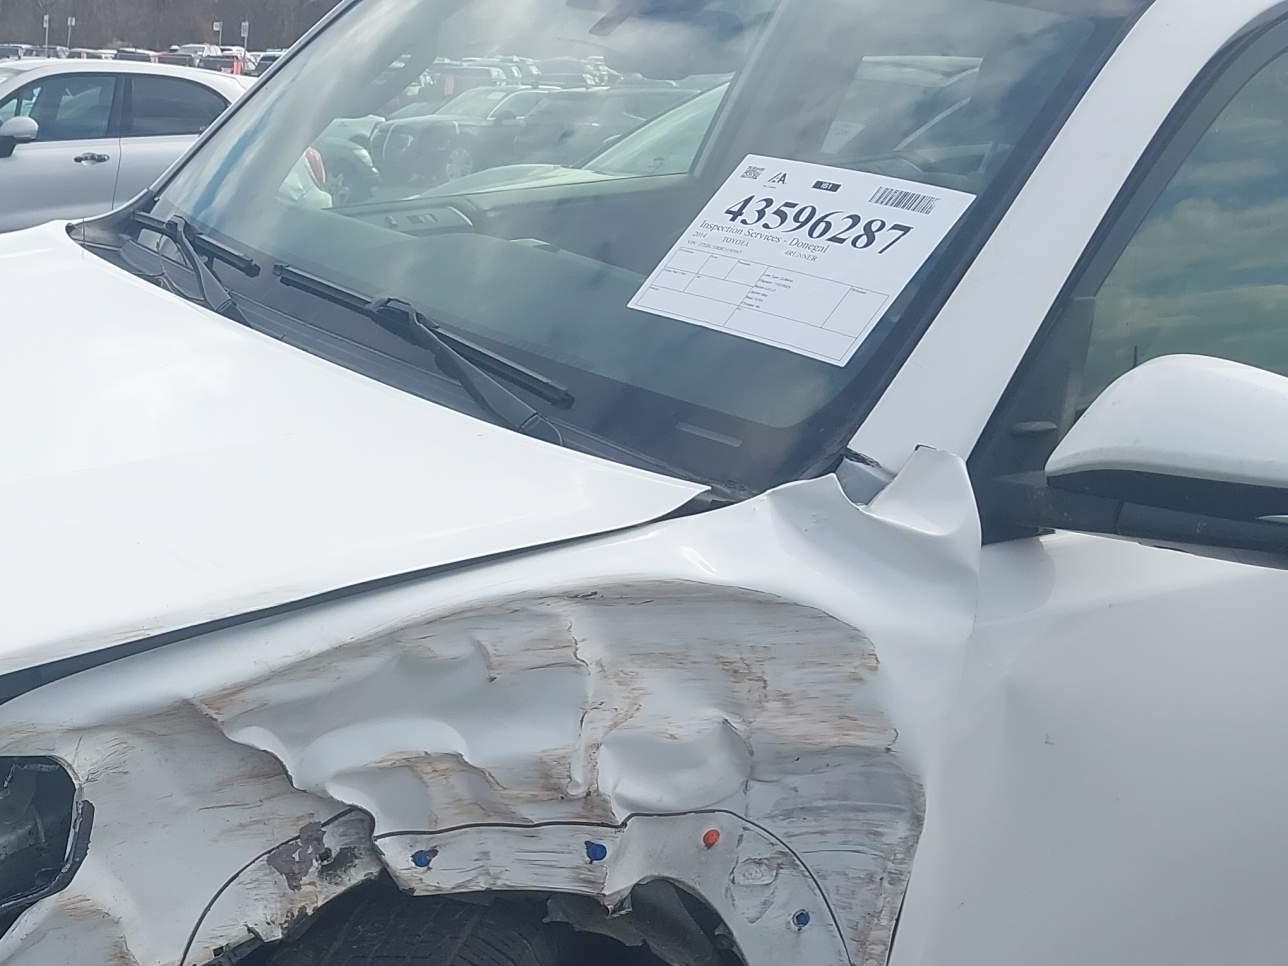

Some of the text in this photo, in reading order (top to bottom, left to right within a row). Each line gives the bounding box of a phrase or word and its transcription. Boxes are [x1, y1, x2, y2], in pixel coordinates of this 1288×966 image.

[700, 220, 743, 235] Inspection
[744, 228, 782, 243] Services
[789, 237, 830, 254] Donegal
[724, 194, 915, 255] 43596287
[722, 236, 750, 248] TOYOTA
